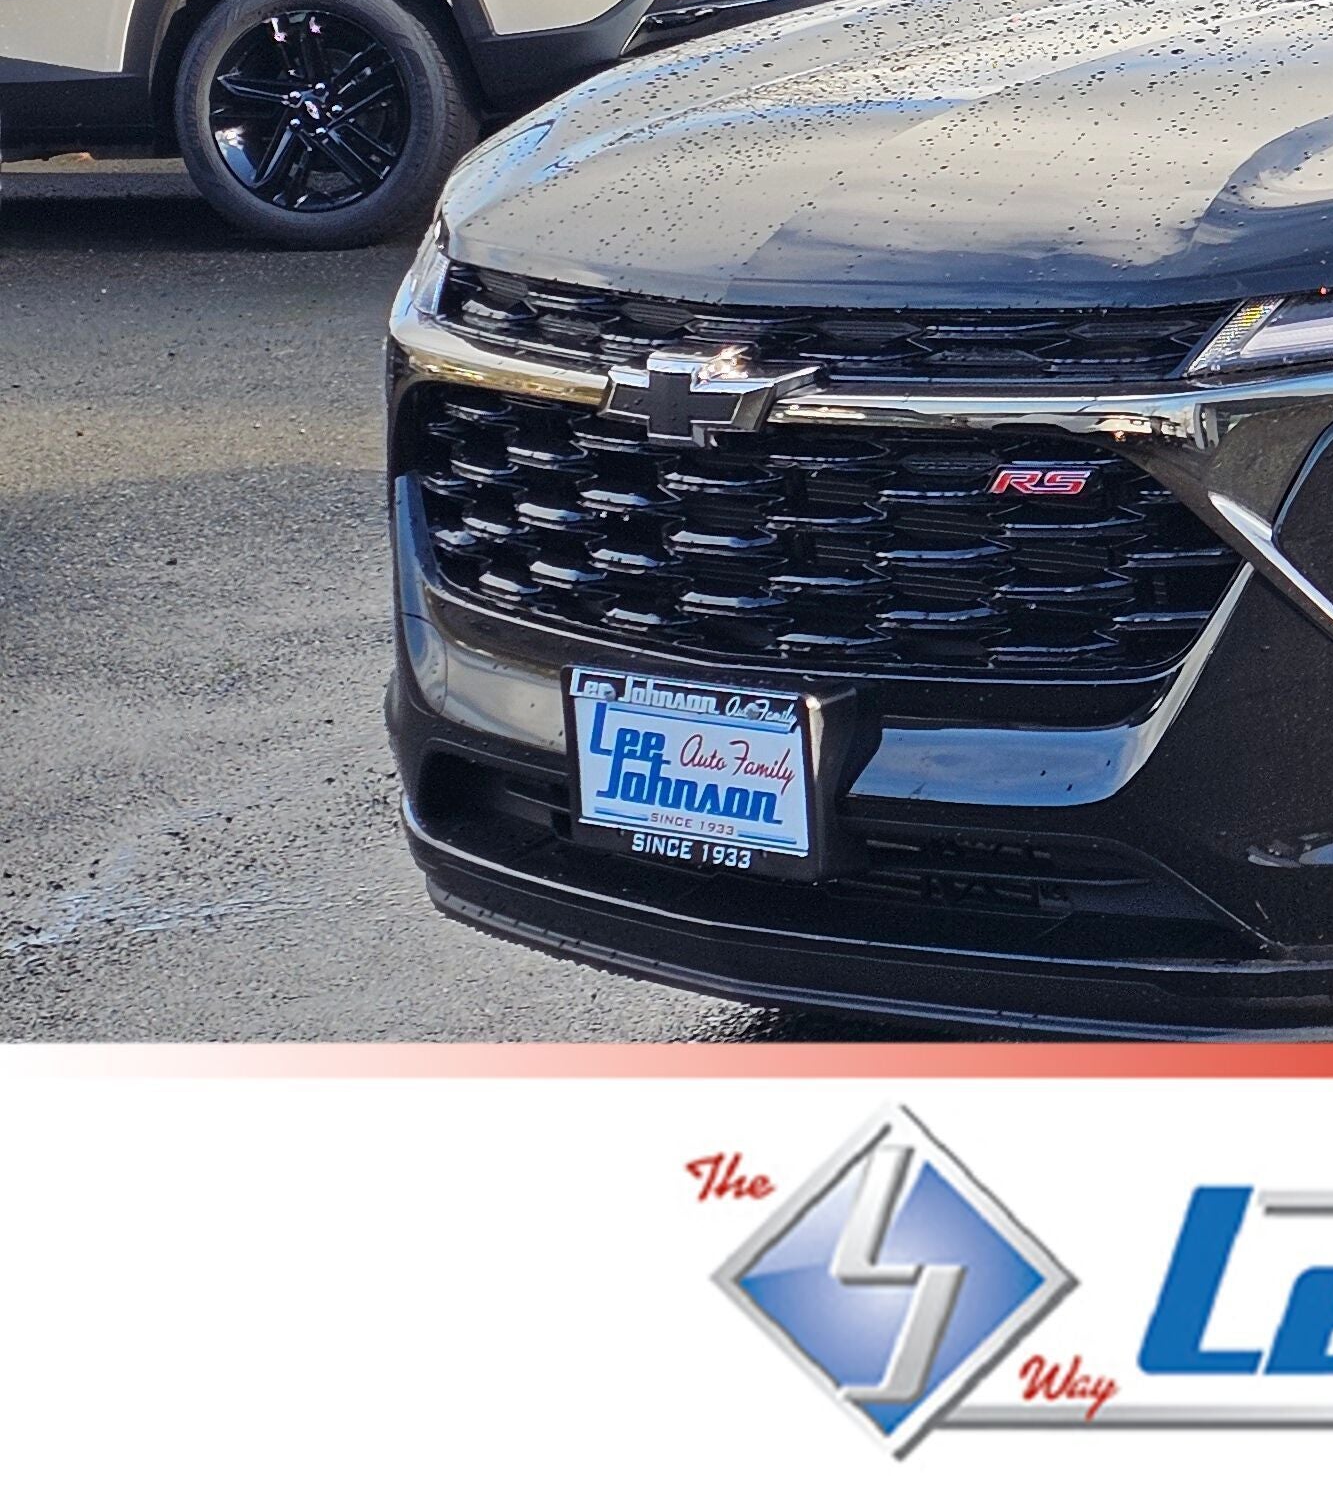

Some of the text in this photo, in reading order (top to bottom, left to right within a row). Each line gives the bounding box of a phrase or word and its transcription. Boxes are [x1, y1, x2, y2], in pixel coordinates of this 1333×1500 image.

[988, 468, 1092, 495] RS
[618, 675, 720, 714] Johnson
[590, 702, 796, 796] Lee Auto Family
[596, 750, 784, 825] Johnson
[651, 811, 736, 837] SINCE 1933
[631, 833, 752, 870] SINCE 1933
